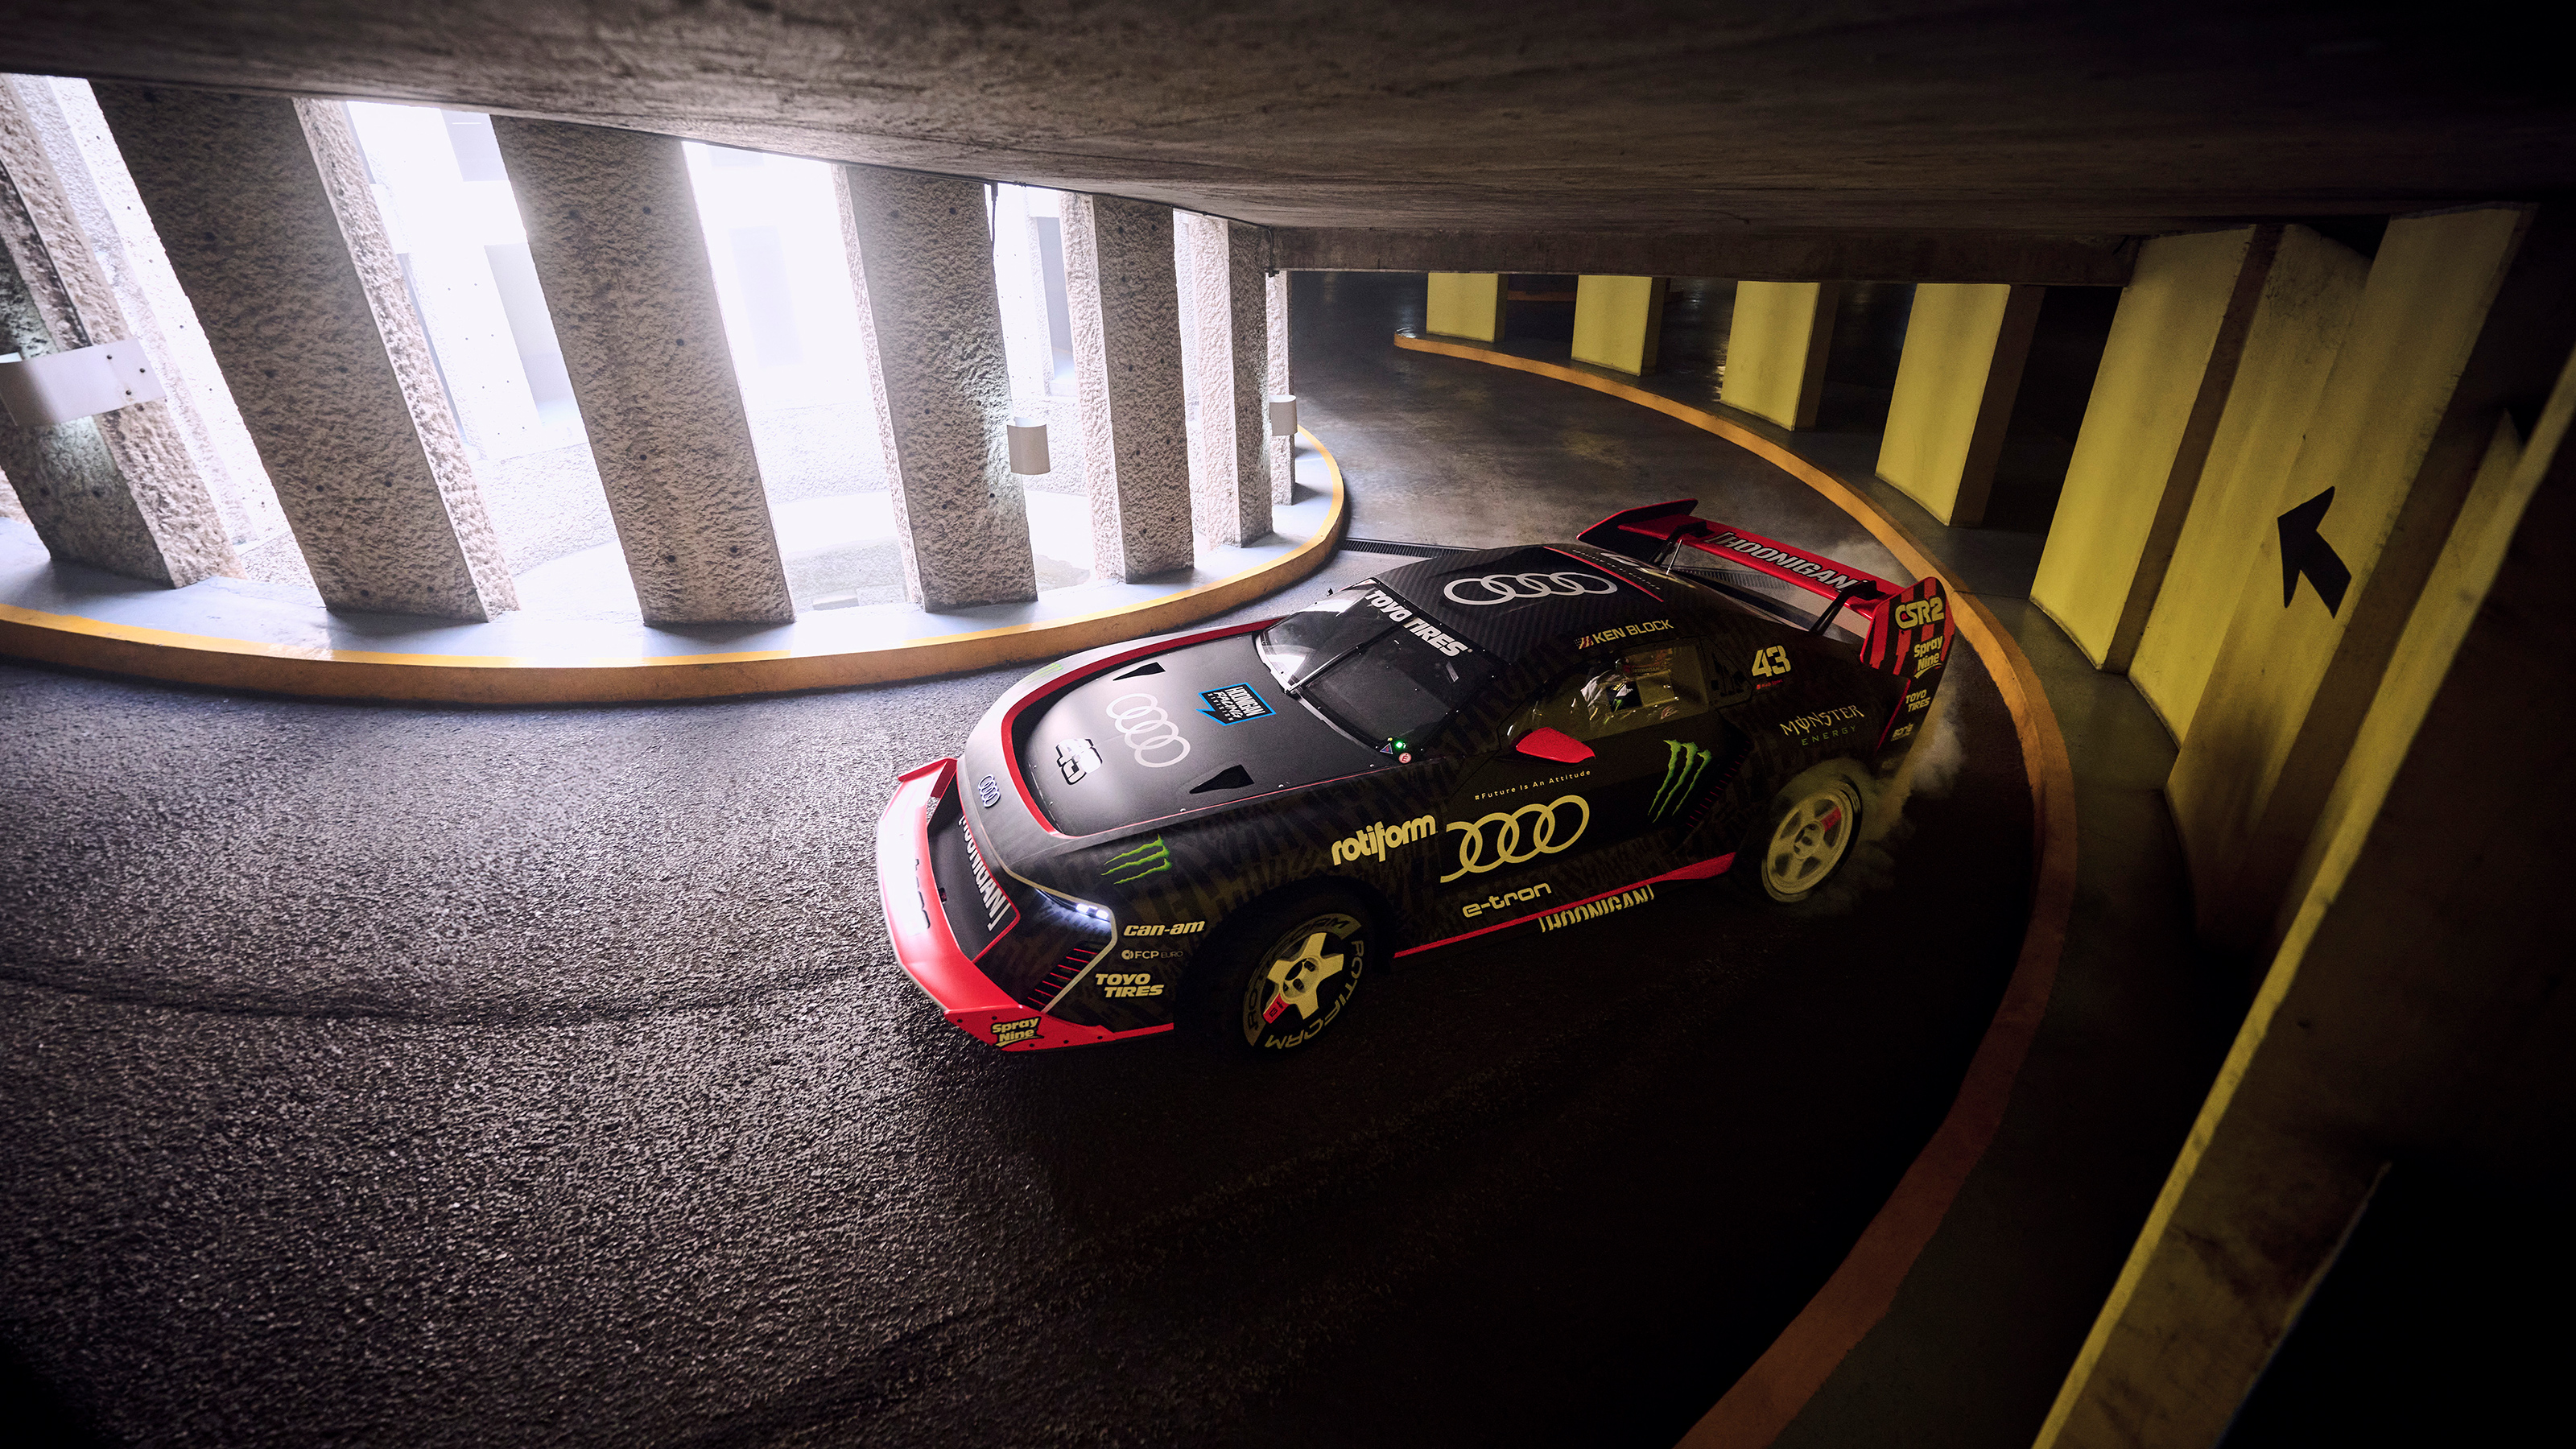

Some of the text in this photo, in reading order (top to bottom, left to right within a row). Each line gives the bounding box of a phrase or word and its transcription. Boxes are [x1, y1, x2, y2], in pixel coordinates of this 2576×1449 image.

[1364, 589, 1468, 657] TOYO TIRES
[1894, 597, 1945, 630] CSR2
[1592, 619, 1674, 644] KEN BLOCK
[1913, 635, 1944, 658] Spray
[1751, 645, 1792, 678] 43
[1918, 651, 1941, 671] Nine
[1213, 691, 1244, 719] RACING
[1224, 686, 1266, 717] HOONIGAN
[1905, 689, 1927, 704] TOYO
[1907, 696, 1931, 713] TIRES
[1779, 705, 1864, 736] MONSTER
[1801, 725, 1857, 746] ENERGY
[1474, 787, 1517, 801] #Future
[1548, 770, 1591, 784] Attitude
[1331, 814, 1438, 866] rotiform
[1462, 882, 1553, 919] e-tron
[1123, 920, 1206, 937] can-am
[1134, 950, 1183, 960] FCP EURO
[1095, 972, 1151, 986] TOYO
[1104, 984, 1165, 998] TIRES
[992, 1018, 1040, 1034] Spray
[999, 1029, 1034, 1042] Nine
